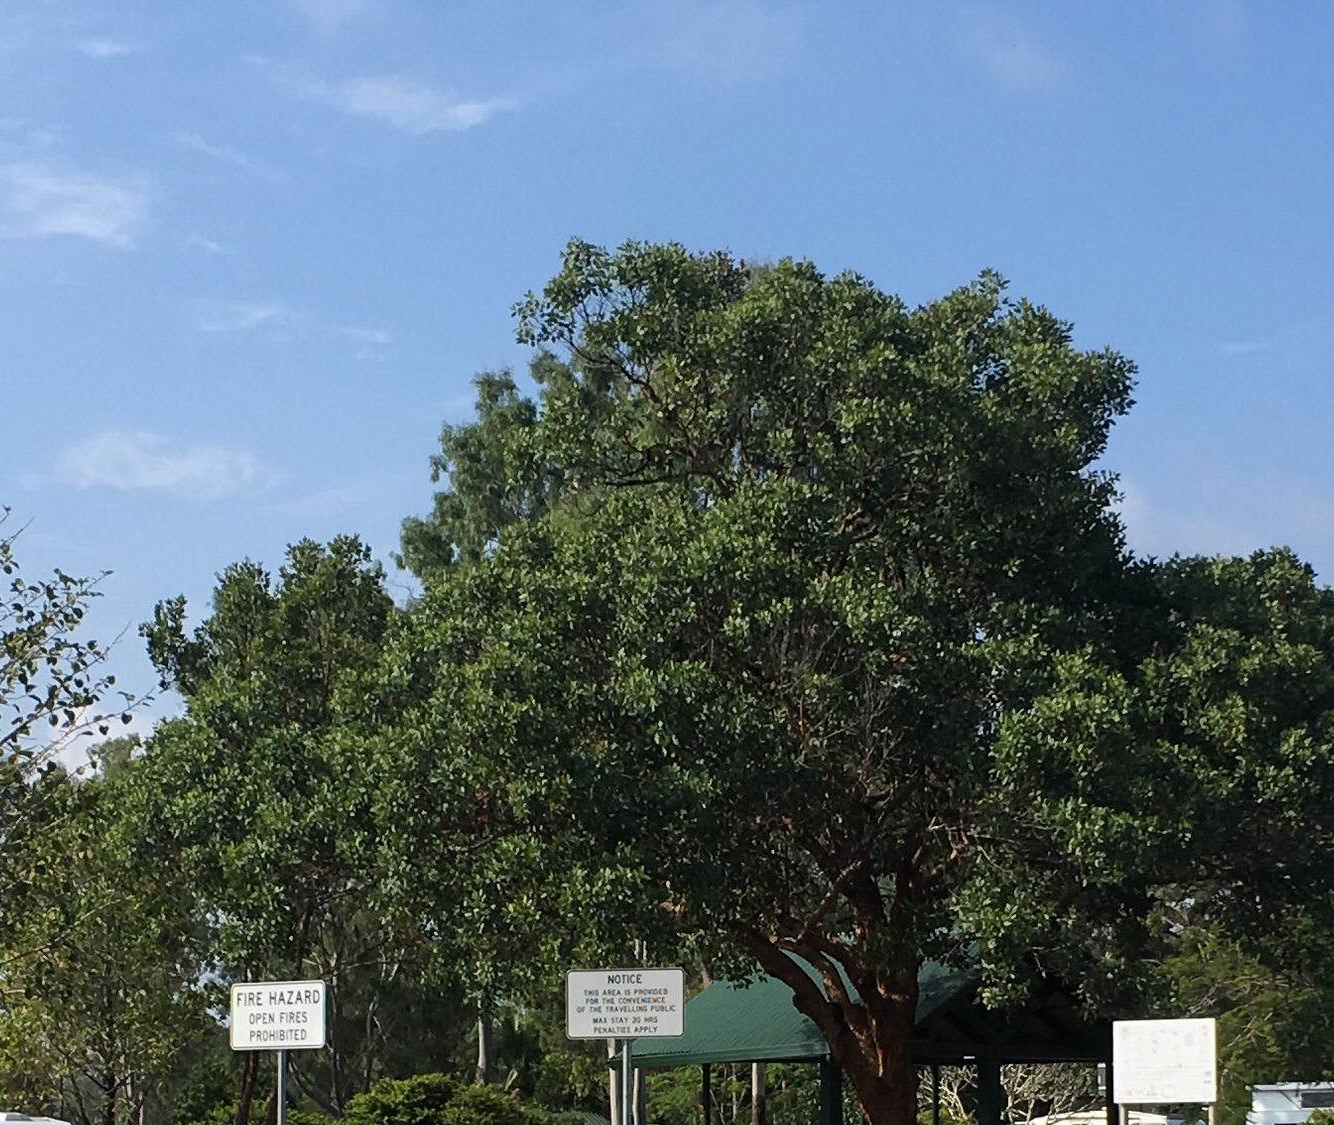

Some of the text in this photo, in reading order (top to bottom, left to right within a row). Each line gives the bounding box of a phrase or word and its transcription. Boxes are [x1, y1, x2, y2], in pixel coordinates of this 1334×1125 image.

[607, 974, 642, 984] NOTICE
[633, 988, 669, 996] PROVIDED
[236, 989, 320, 1007] FIRE HAZARD
[618, 996, 666, 1004] CONVENIENCE
[606, 1005, 647, 1013] TRAVELLING
[650, 1004, 676, 1012] PUBLIC
[249, 1011, 308, 1025] OPEN FIRES
[593, 1026, 631, 1034] PENALTIES
[249, 1028, 307, 1042] PROHIBITED
